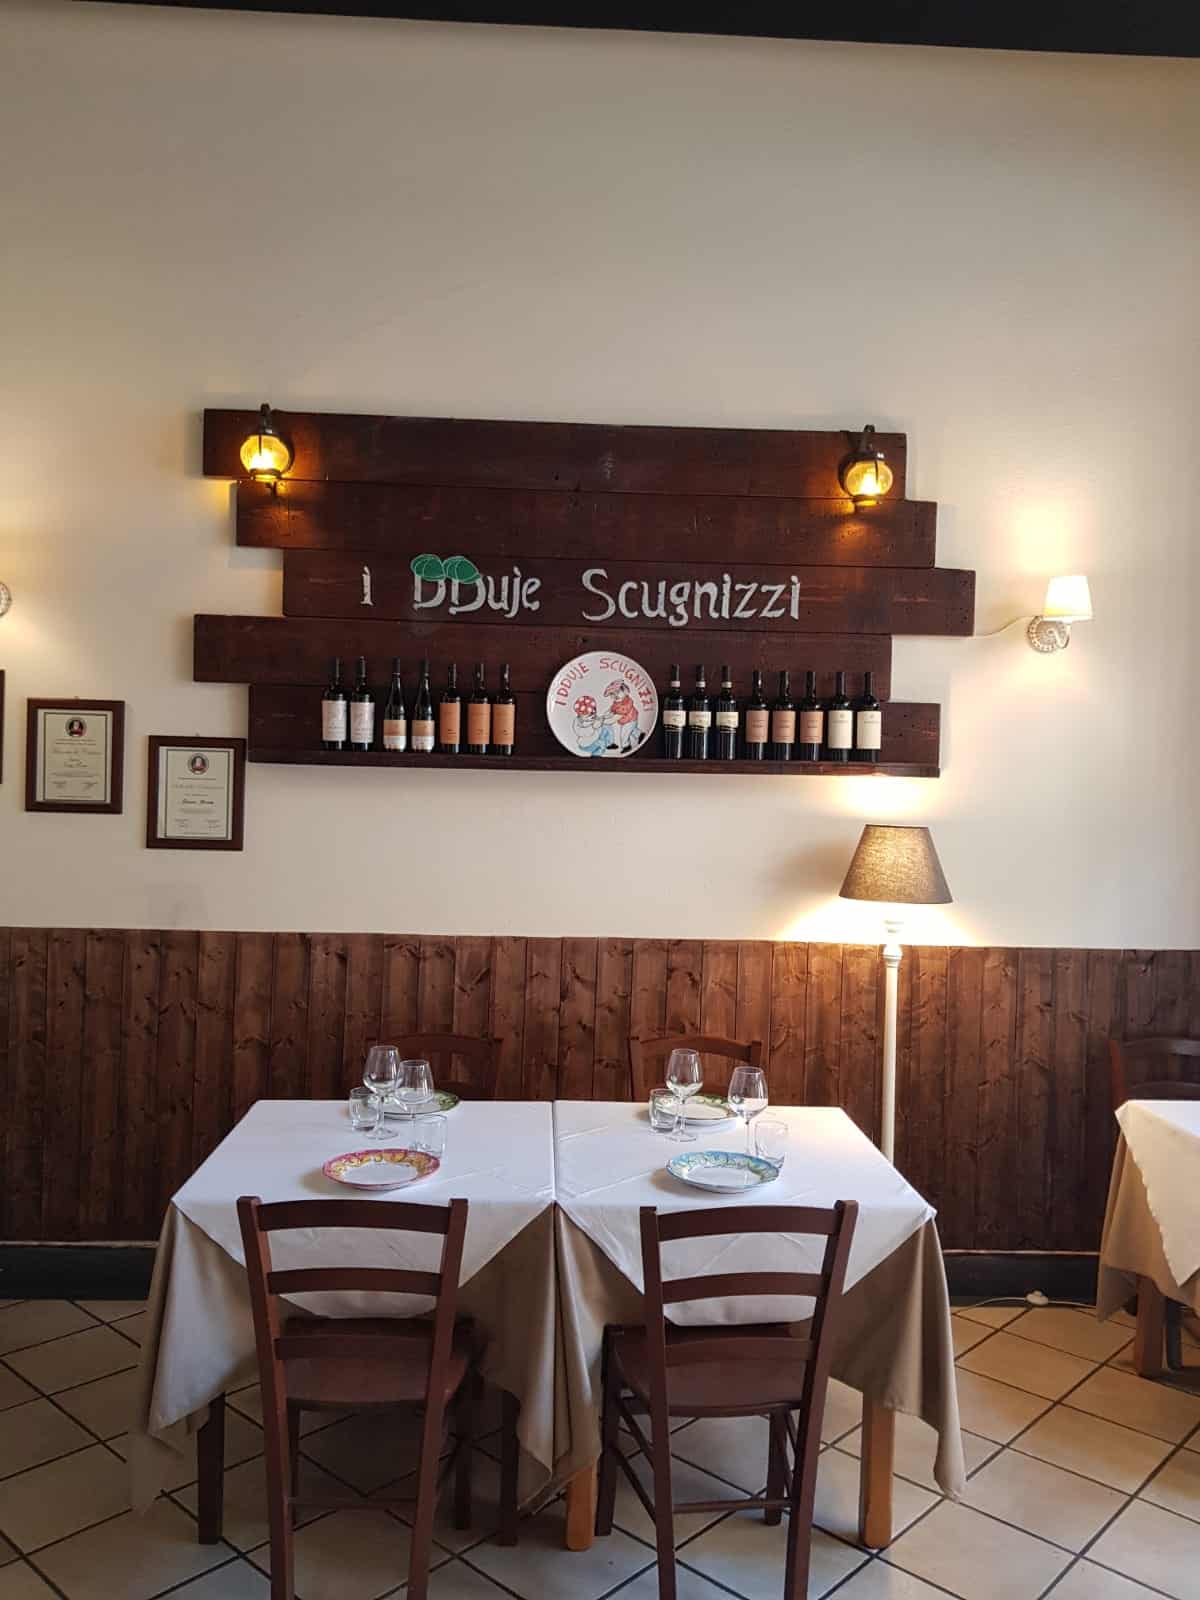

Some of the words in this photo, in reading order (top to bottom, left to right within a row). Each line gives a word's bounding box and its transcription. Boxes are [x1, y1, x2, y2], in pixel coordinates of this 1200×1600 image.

[413, 564, 542, 618] DDuje
[581, 568, 801, 627] Scugnizzi
[599, 657, 655, 711] SCUGNIZZI
